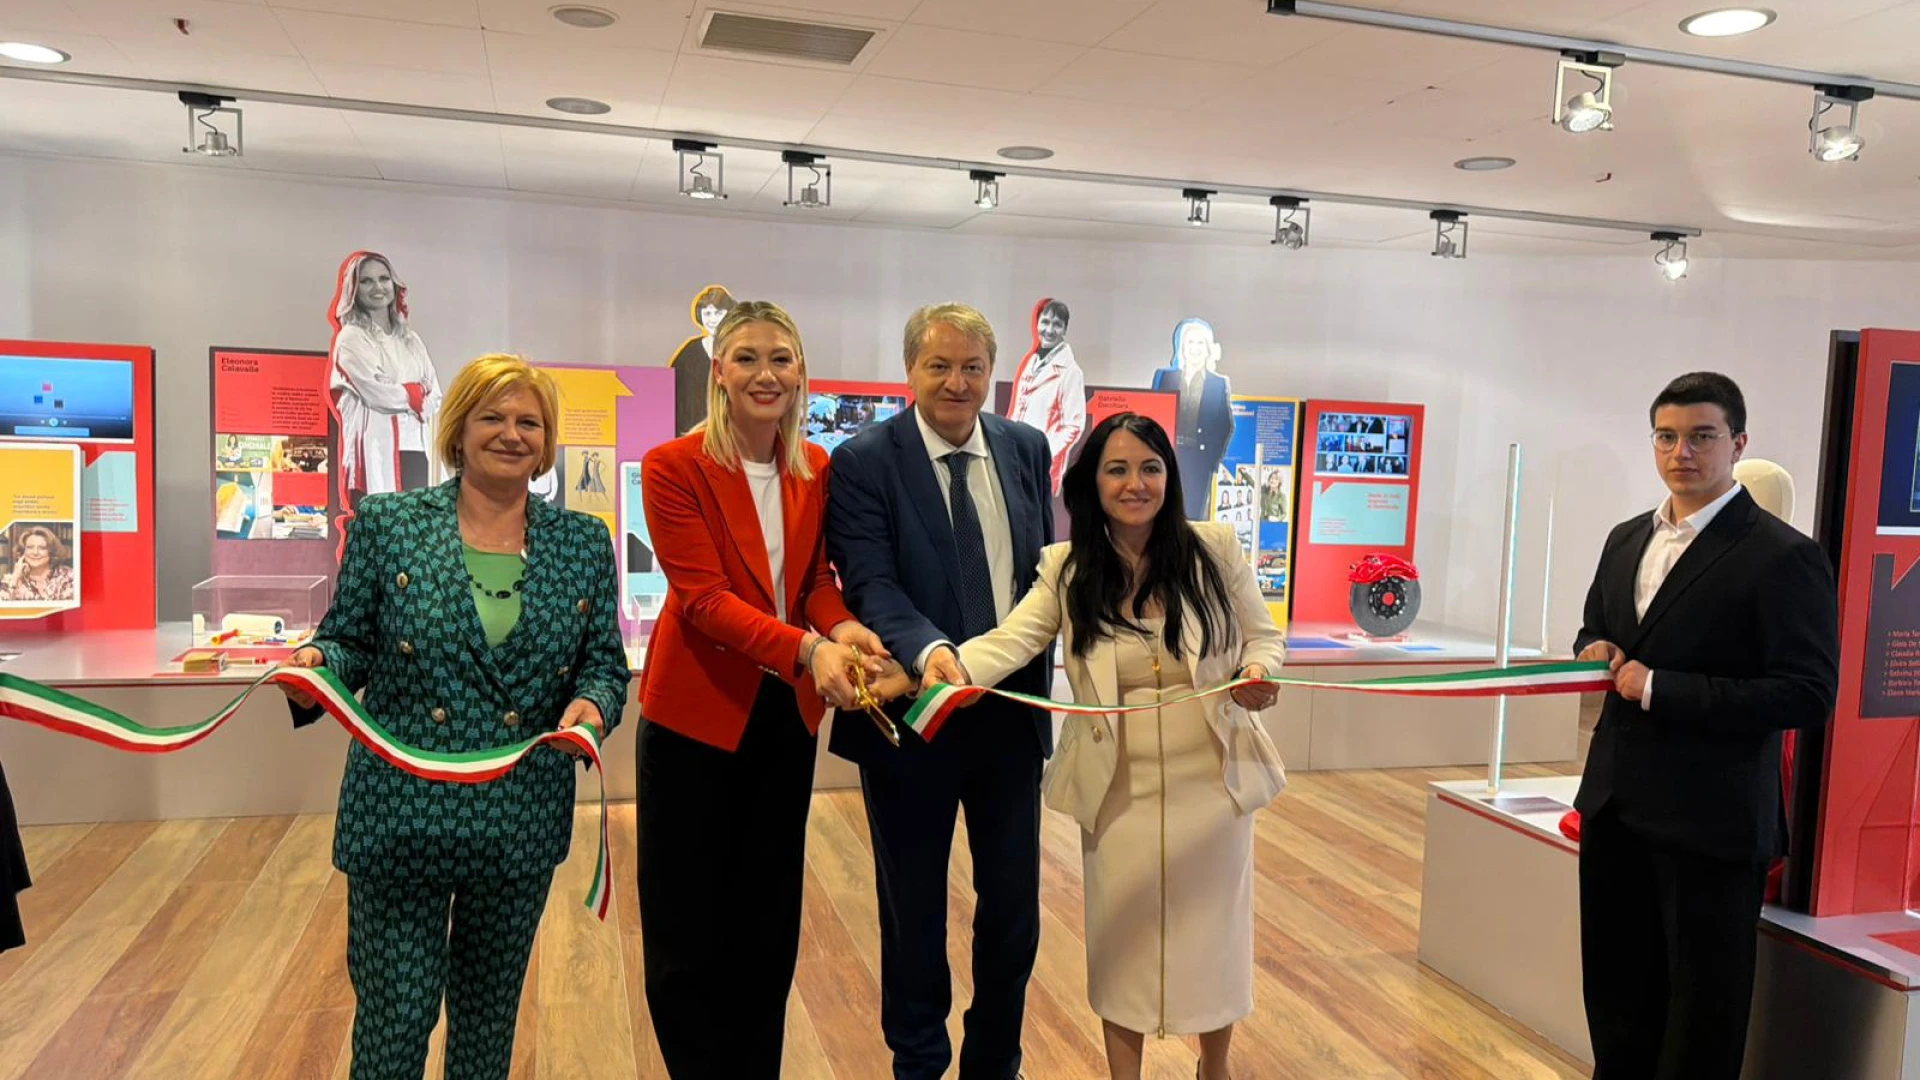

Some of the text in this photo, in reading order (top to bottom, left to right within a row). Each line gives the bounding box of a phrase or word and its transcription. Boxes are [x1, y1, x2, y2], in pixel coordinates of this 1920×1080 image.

[221, 357, 258, 366] Eleonora
[221, 365, 259, 373] Calavalle
[1890, 649, 1913, 658] Claudia
[1888, 679, 1912, 687] Barbara
